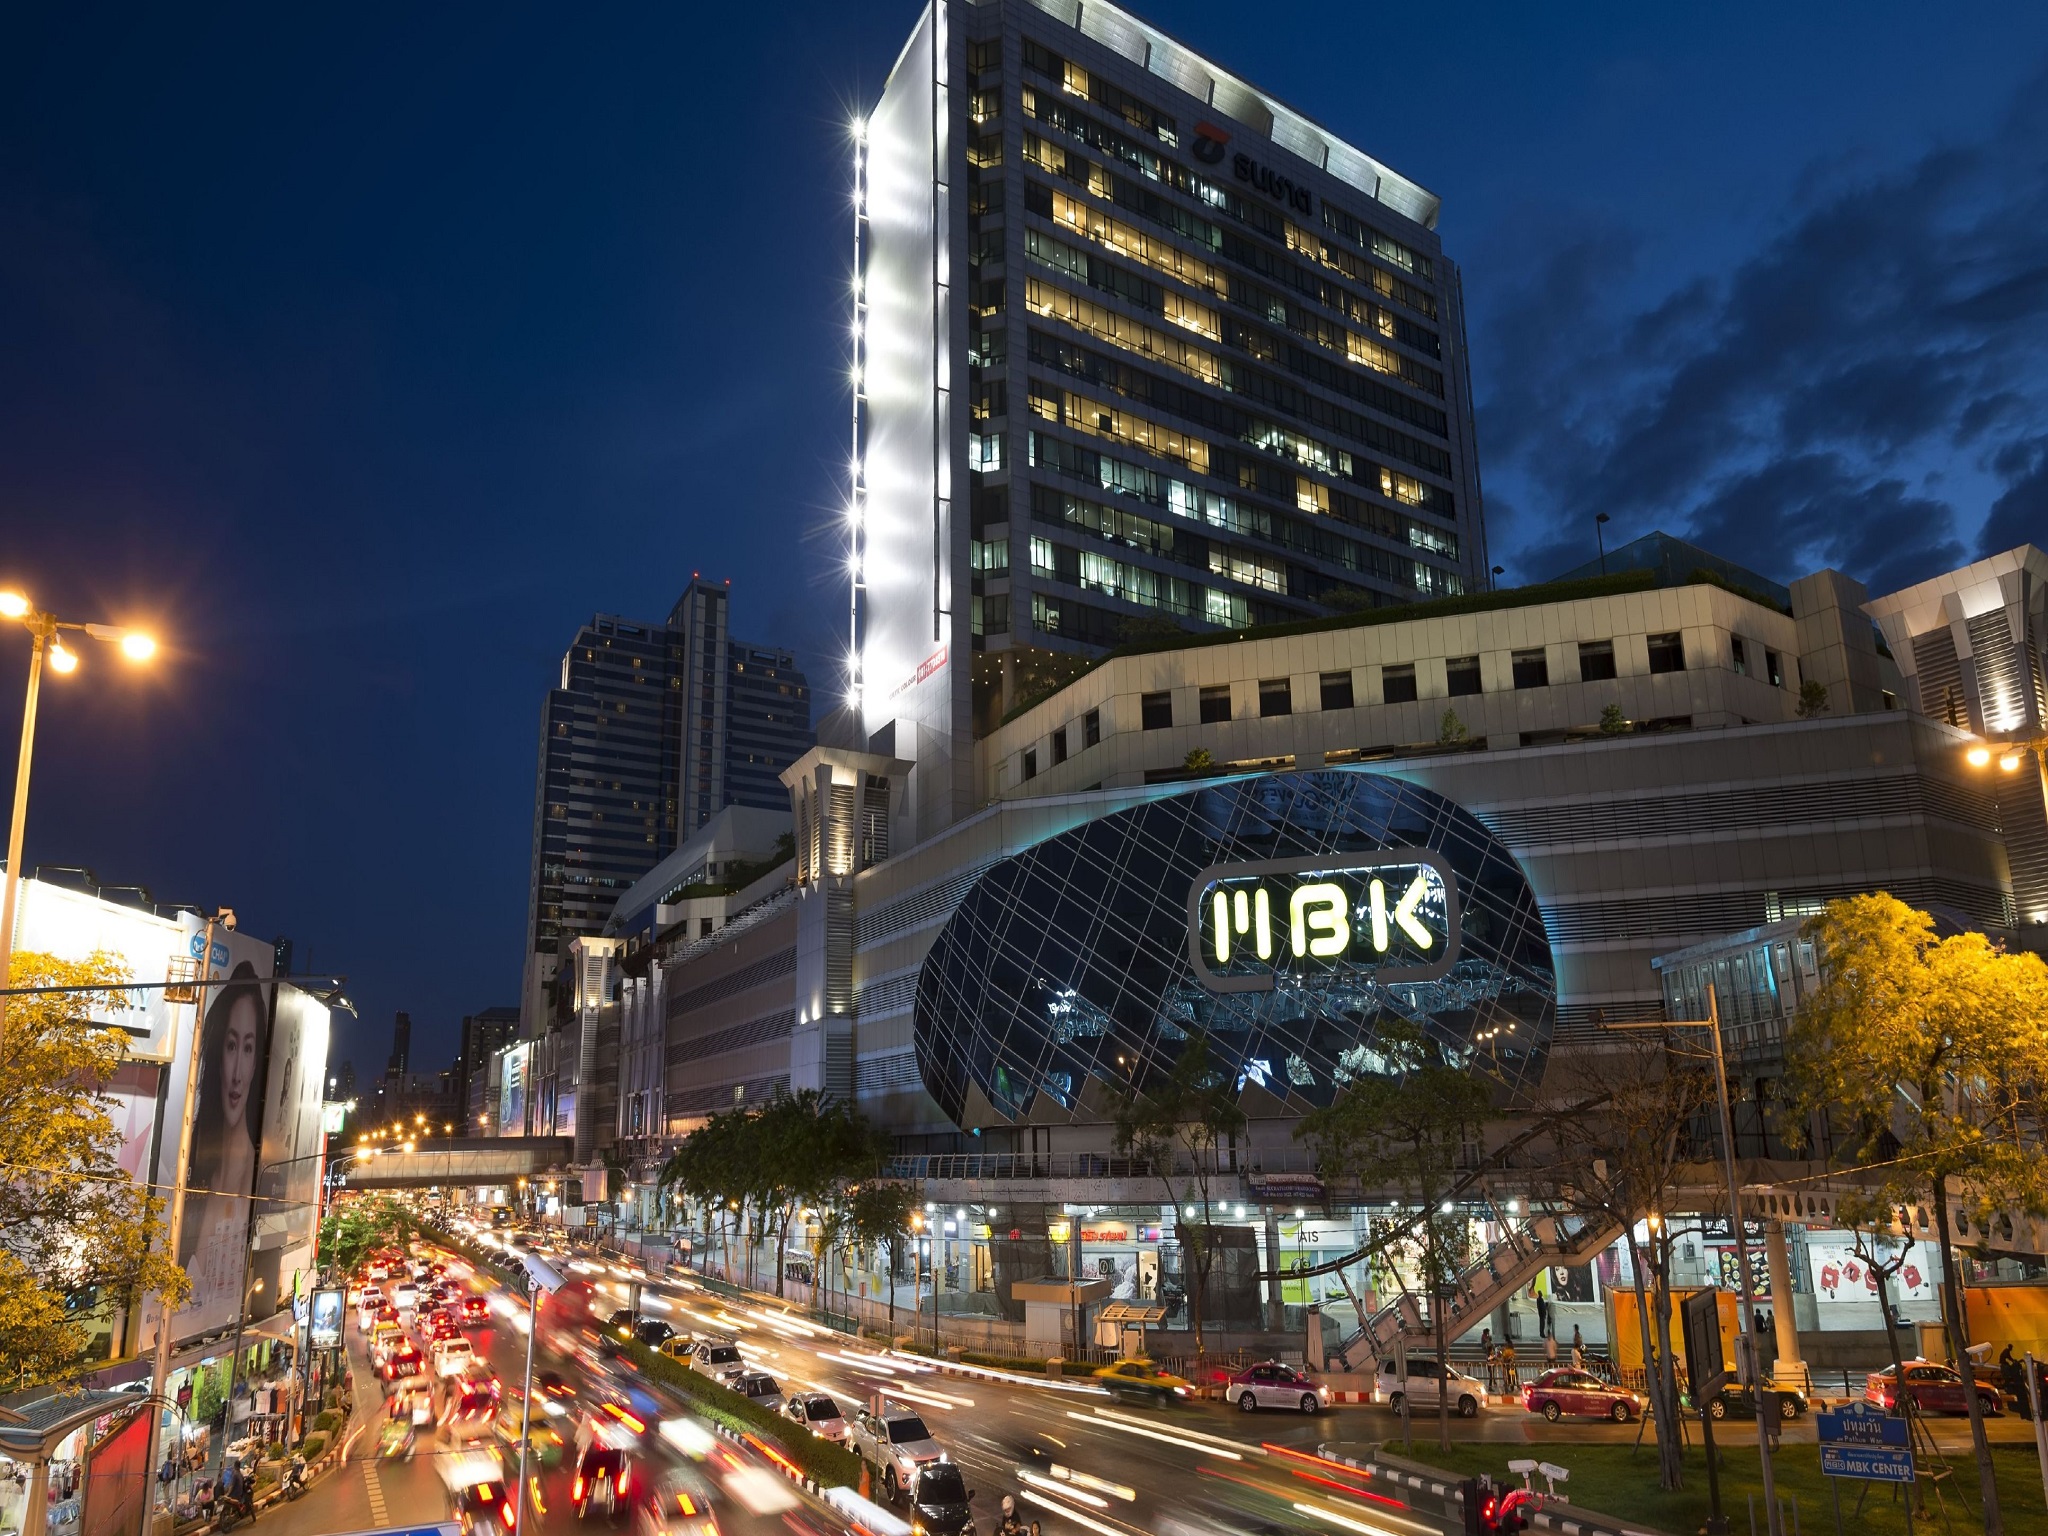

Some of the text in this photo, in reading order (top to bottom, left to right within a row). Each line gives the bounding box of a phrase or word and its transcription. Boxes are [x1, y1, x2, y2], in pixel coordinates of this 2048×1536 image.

[1213, 876, 1433, 963] MBK
[1299, 1231, 1319, 1243] AIS
[1842, 1418, 1882, 1436] ปทุมวัน
[1846, 1461, 1870, 1473] MBK
[1872, 1463, 1911, 1476] CENTER
